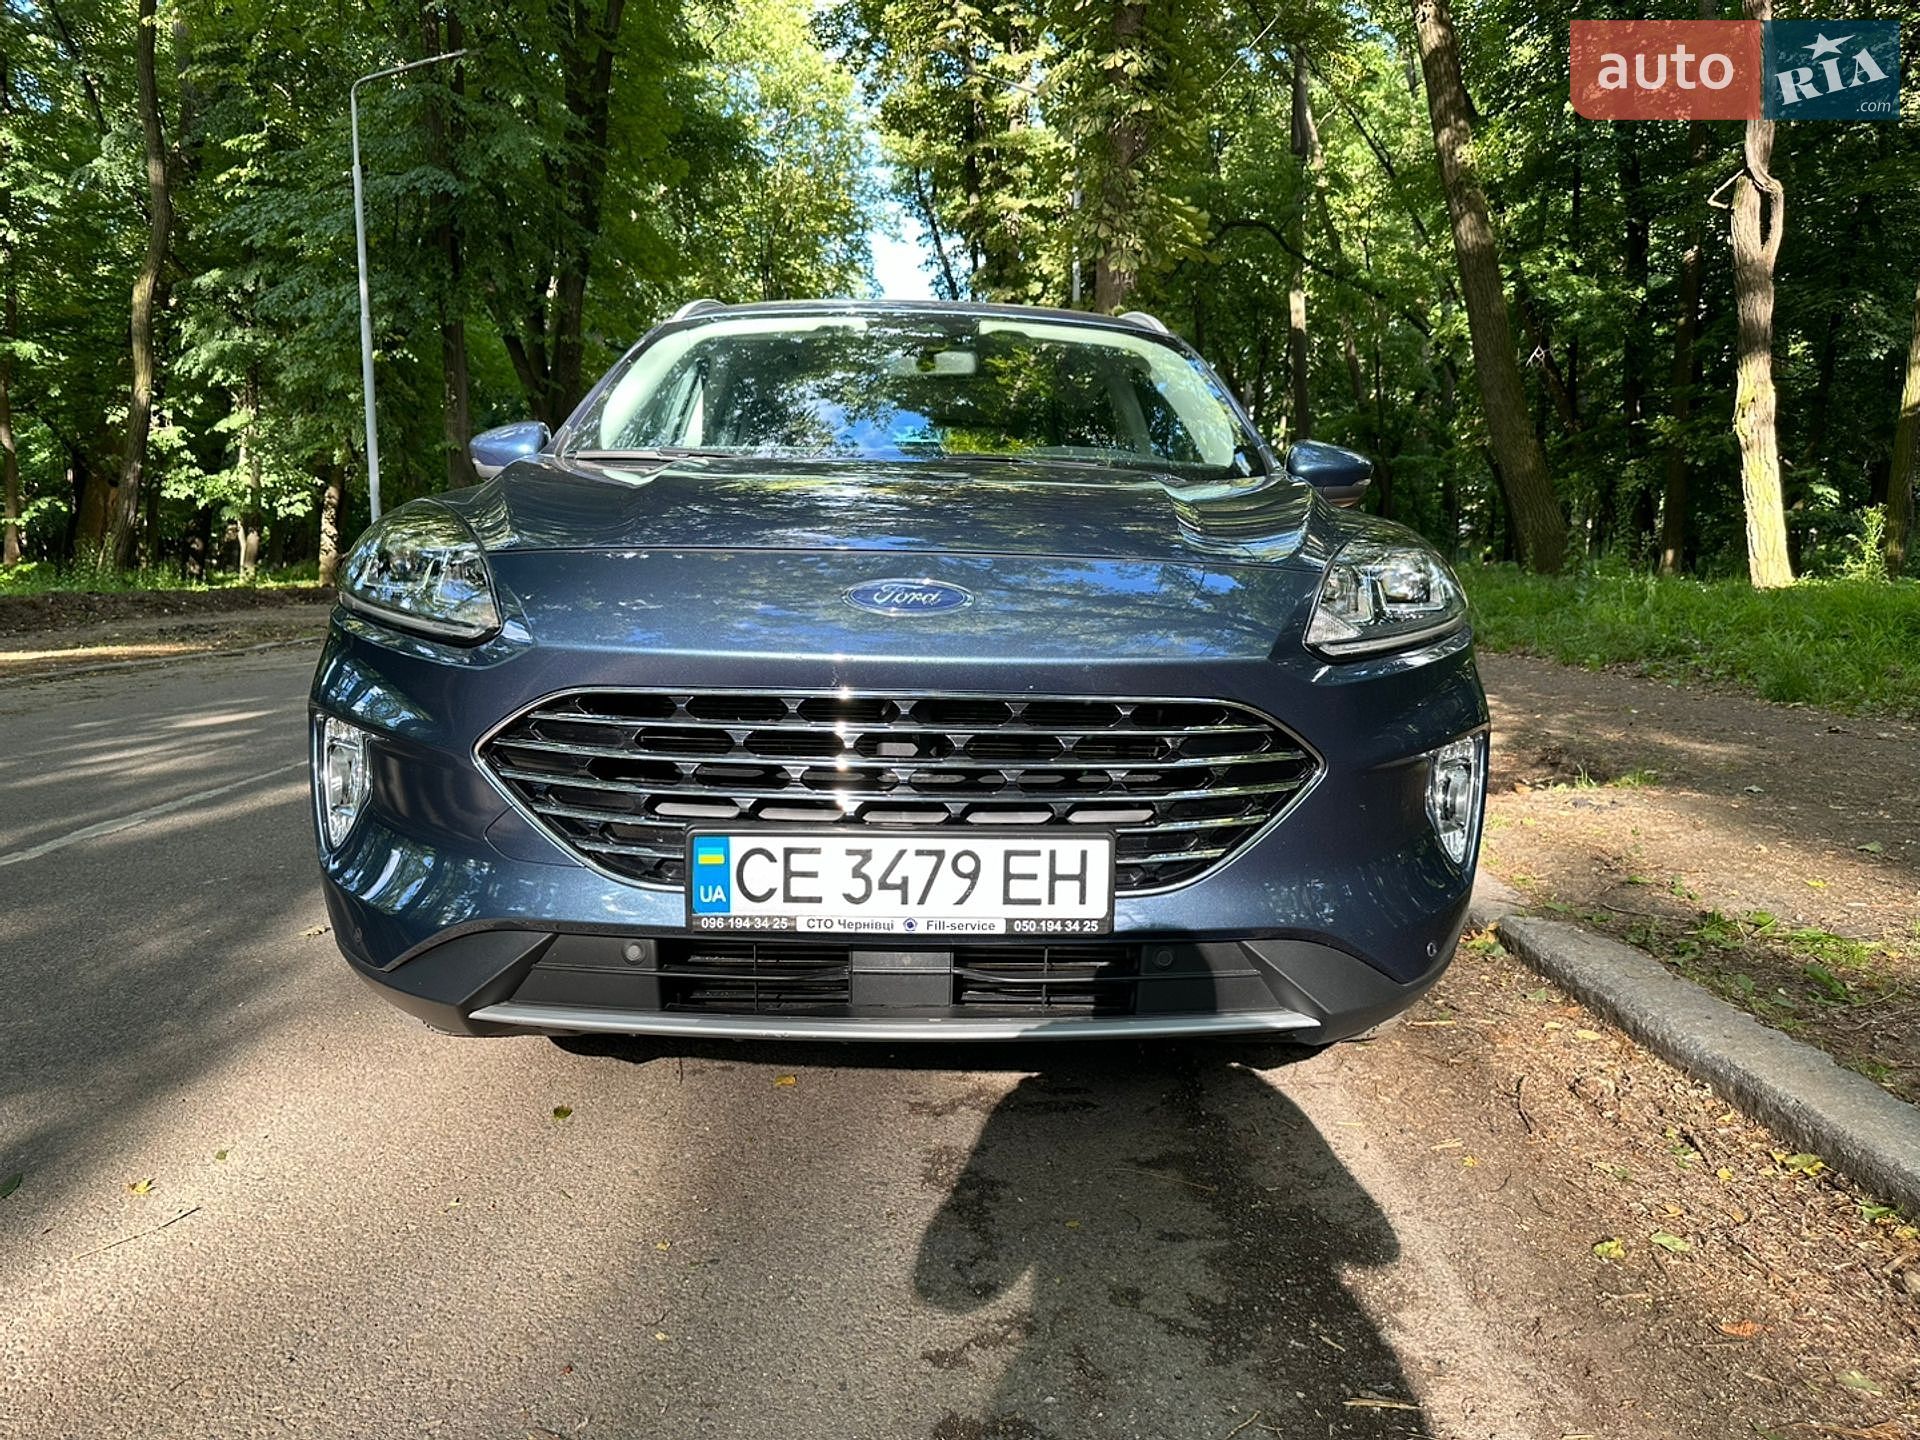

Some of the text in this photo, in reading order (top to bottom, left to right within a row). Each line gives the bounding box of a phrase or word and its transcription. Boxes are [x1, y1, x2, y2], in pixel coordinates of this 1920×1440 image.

[873, 583, 941, 606] Ford
[735, 846, 1088, 906] CE 3479 EH
[699, 886, 727, 903] UA
[701, 917, 788, 929] 096 194 34 25
[806, 918, 996, 931] СТО Чернівці Fill-service
[1013, 920, 1099, 932] 050 194 34 25
